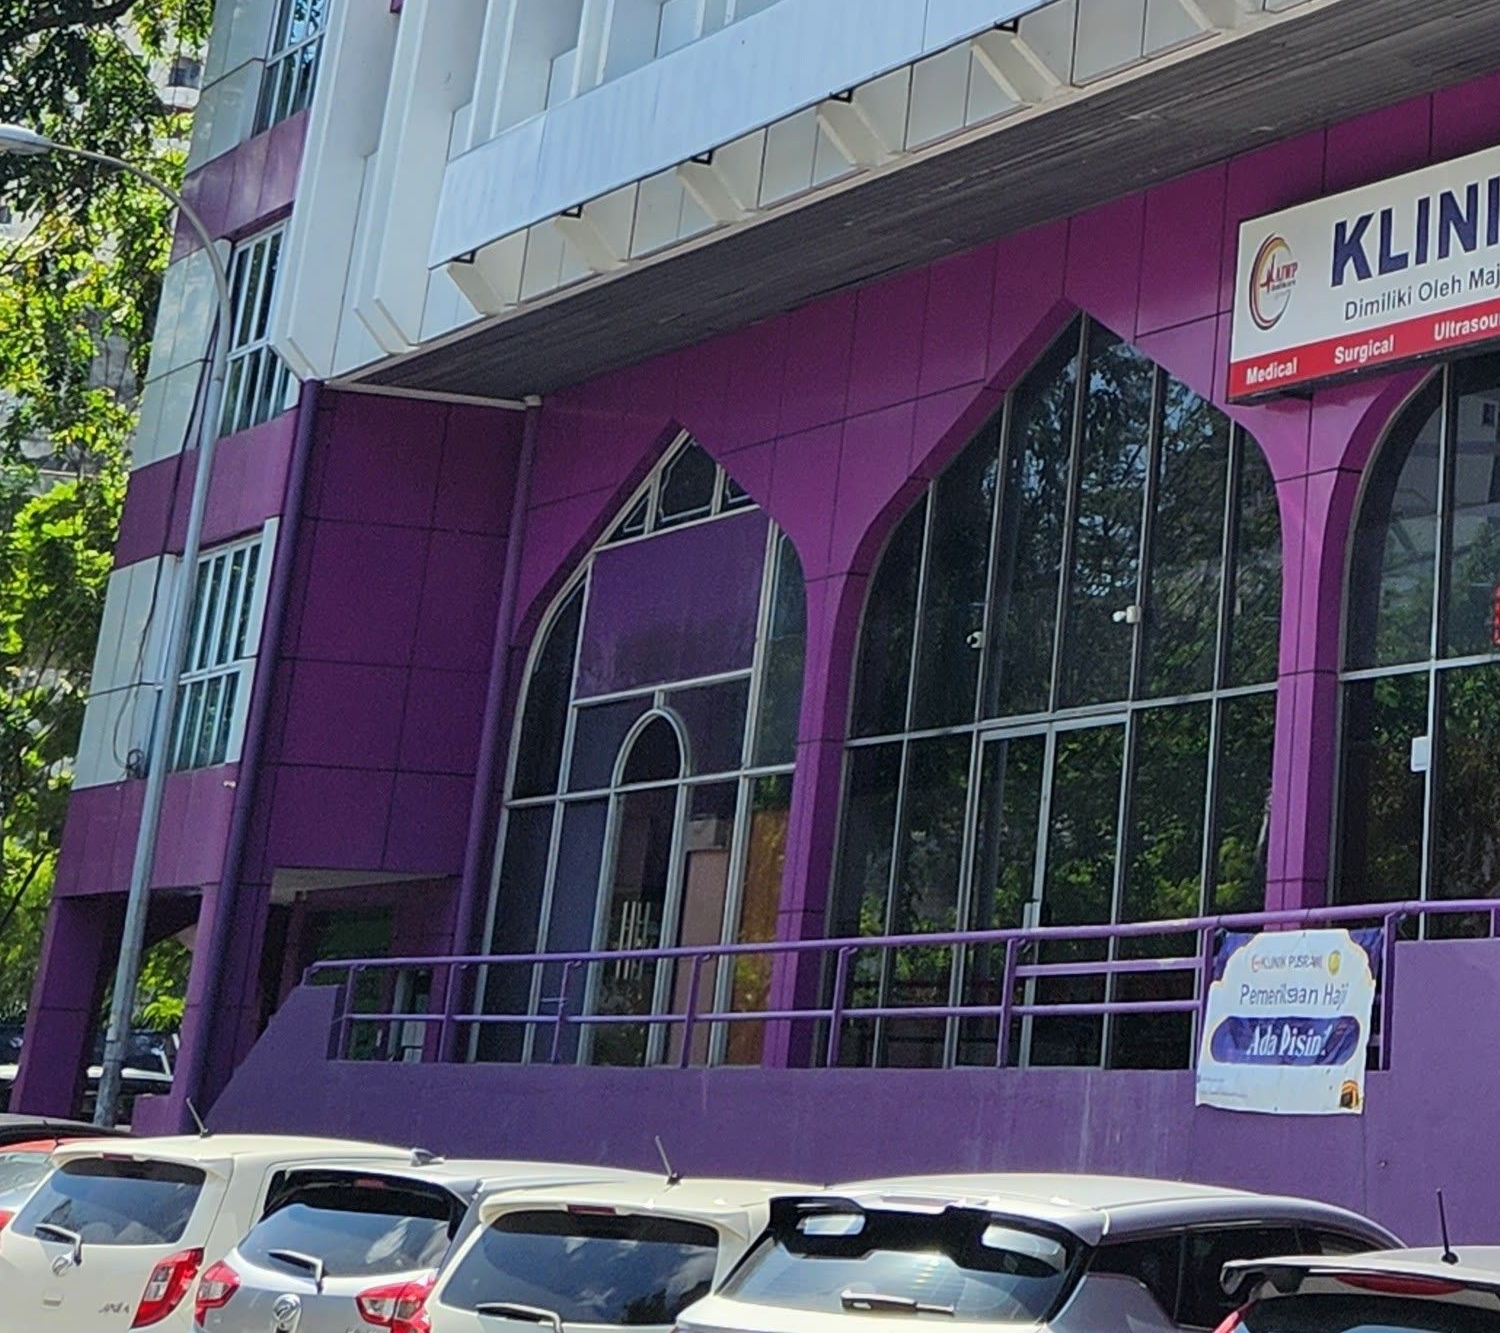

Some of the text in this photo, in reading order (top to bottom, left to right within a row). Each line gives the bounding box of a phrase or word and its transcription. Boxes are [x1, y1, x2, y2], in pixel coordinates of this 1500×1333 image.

[1344, 294, 1413, 321] Dimiliki
[1418, 276, 1463, 302] Oleh
[1246, 358, 1298, 385] Medical
[1334, 335, 1394, 366] Surgical
[1323, 982, 1349, 1011] Haji
[1246, 1025, 1278, 1056] Ada
